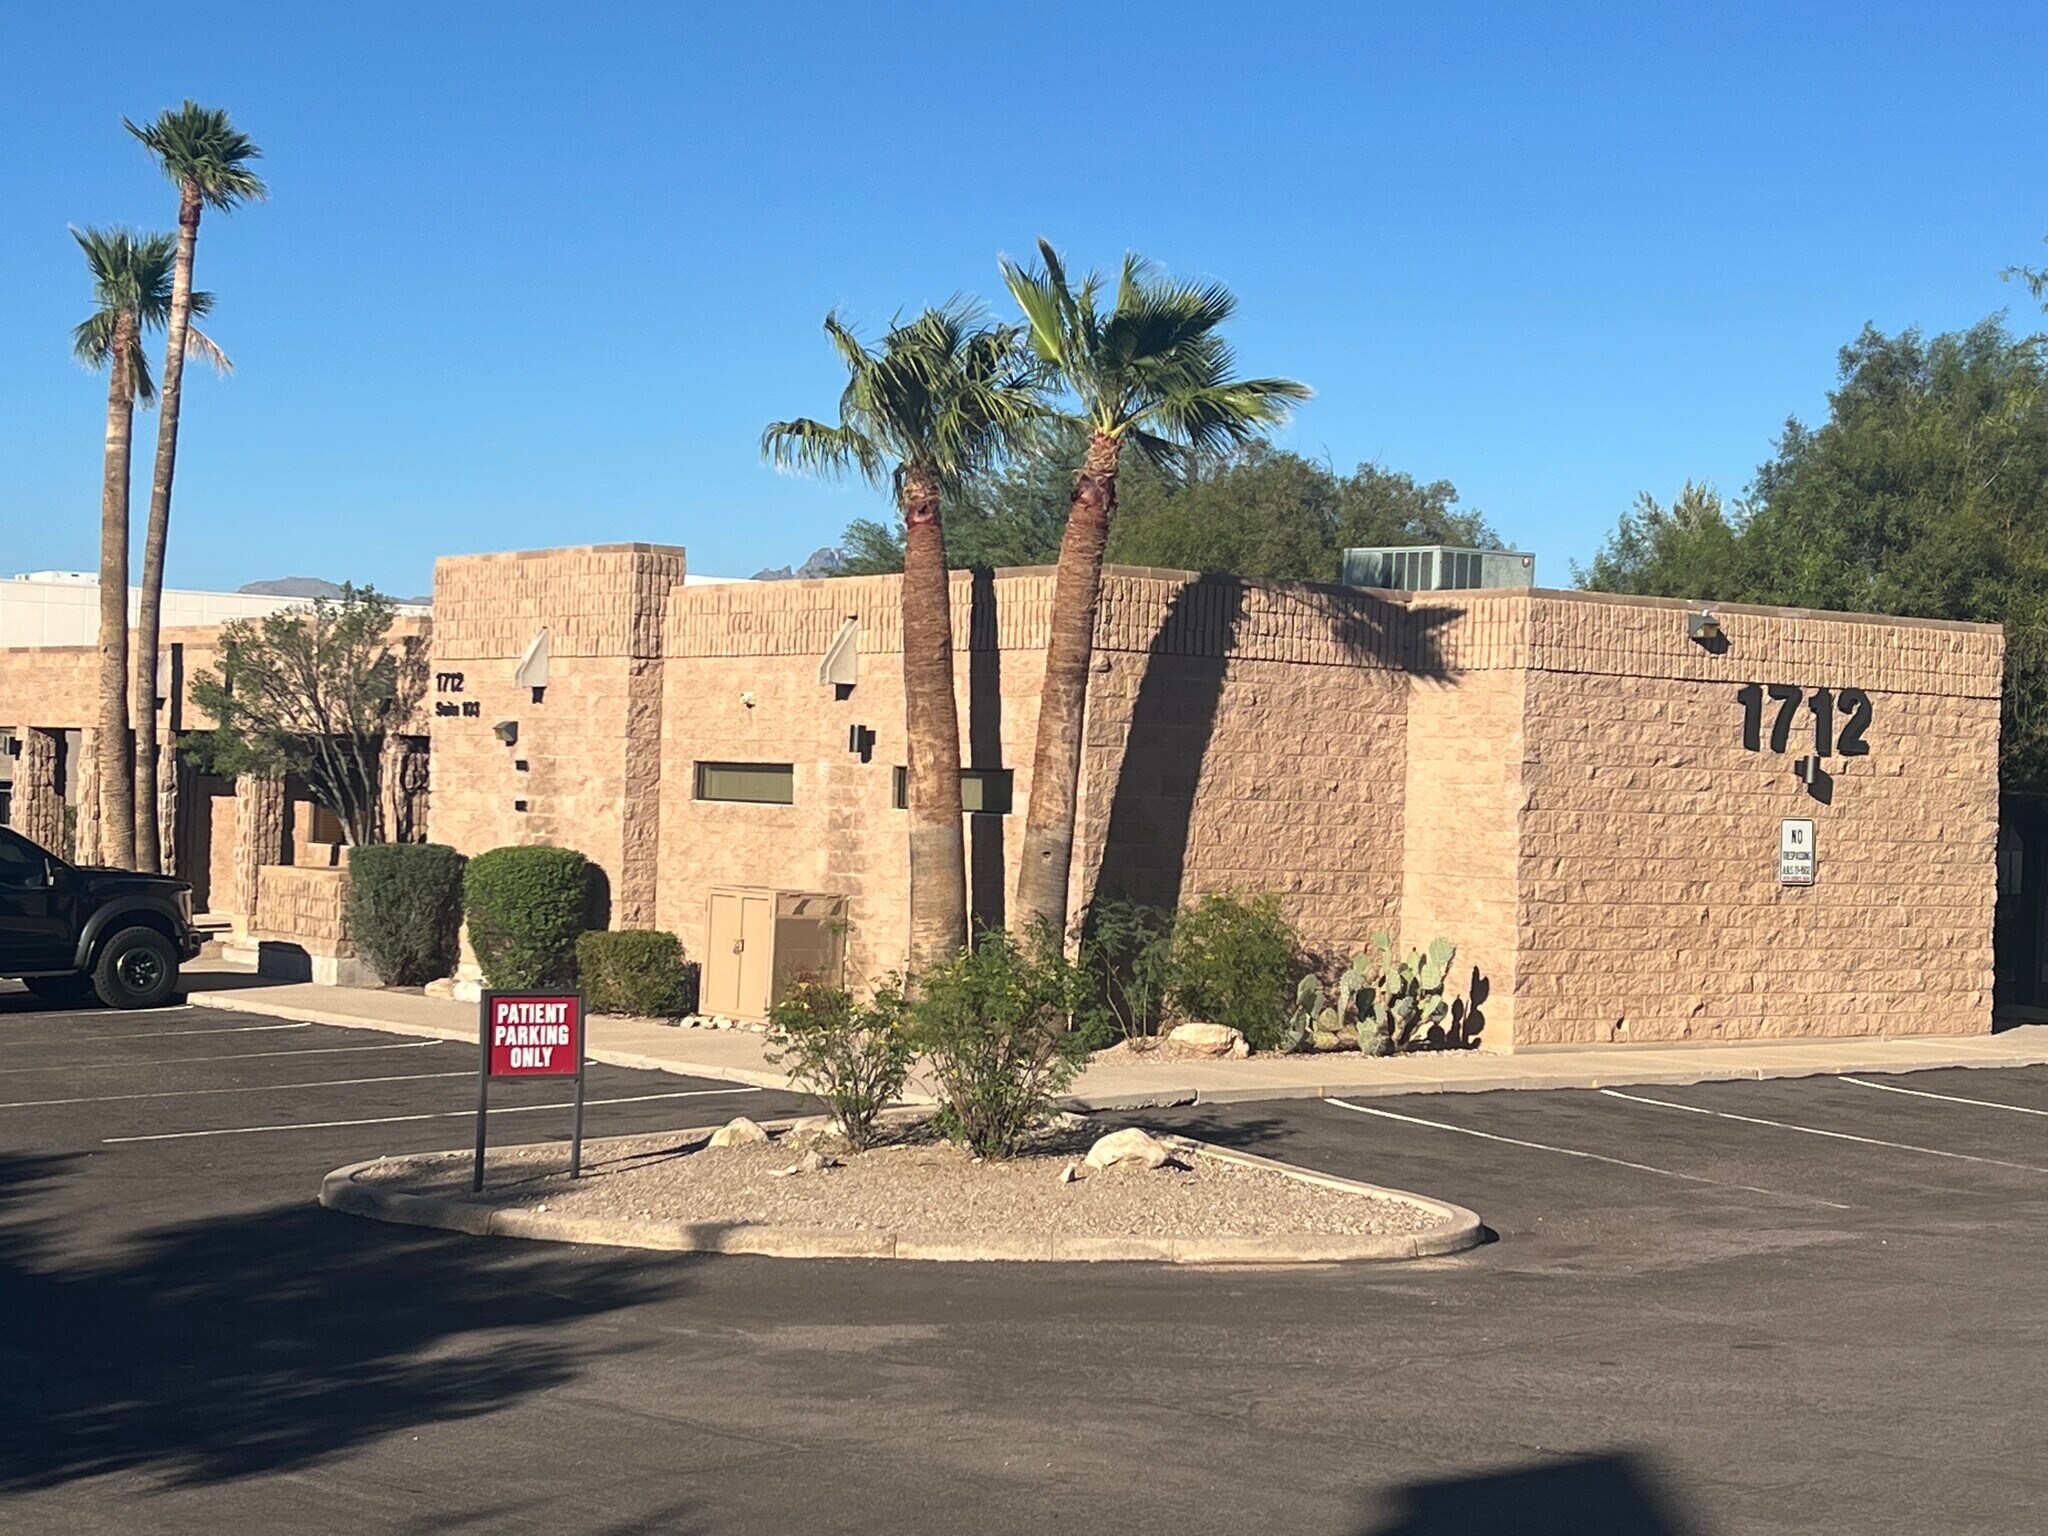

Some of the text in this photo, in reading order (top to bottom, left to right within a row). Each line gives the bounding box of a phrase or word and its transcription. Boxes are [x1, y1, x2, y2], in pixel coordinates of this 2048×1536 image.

[436, 672, 464, 692] 1712
[1738, 684, 1872, 757] 1712
[1791, 829, 1803, 844] NO
[497, 1003, 568, 1024] PATIENT
[494, 1025, 570, 1046] PARKING
[510, 1047, 553, 1068] ONLY
